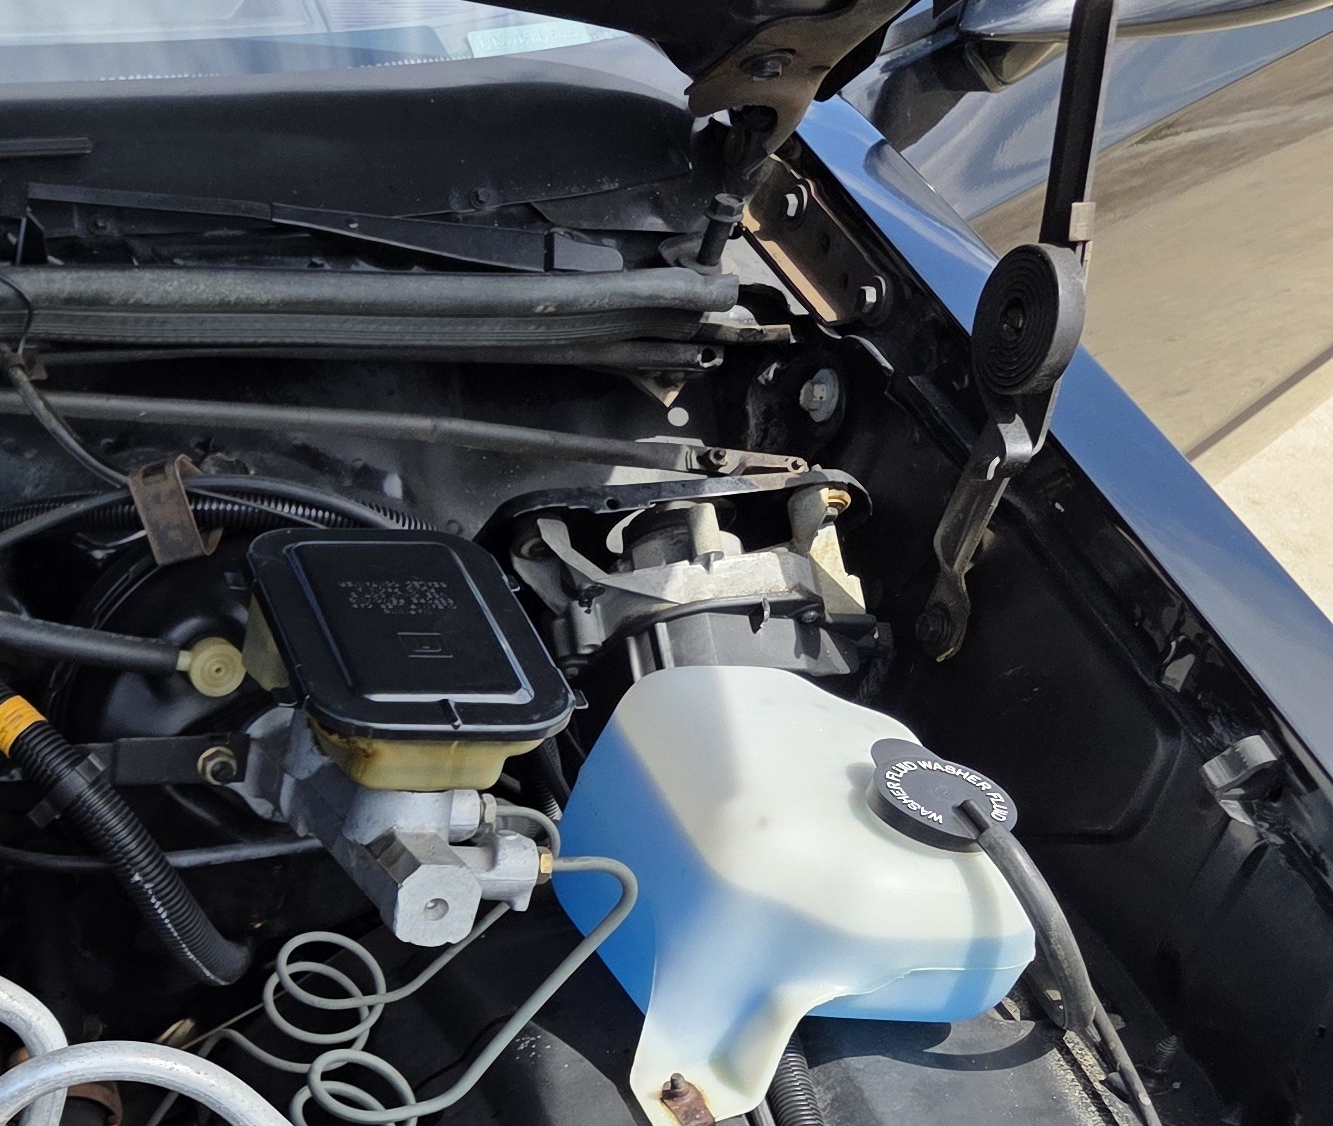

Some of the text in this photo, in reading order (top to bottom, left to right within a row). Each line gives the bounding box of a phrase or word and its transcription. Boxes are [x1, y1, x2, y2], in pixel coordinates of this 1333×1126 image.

[886, 761, 943, 823] WASHER FLUID
[917, 760, 1008, 821] WASHER FLUID
